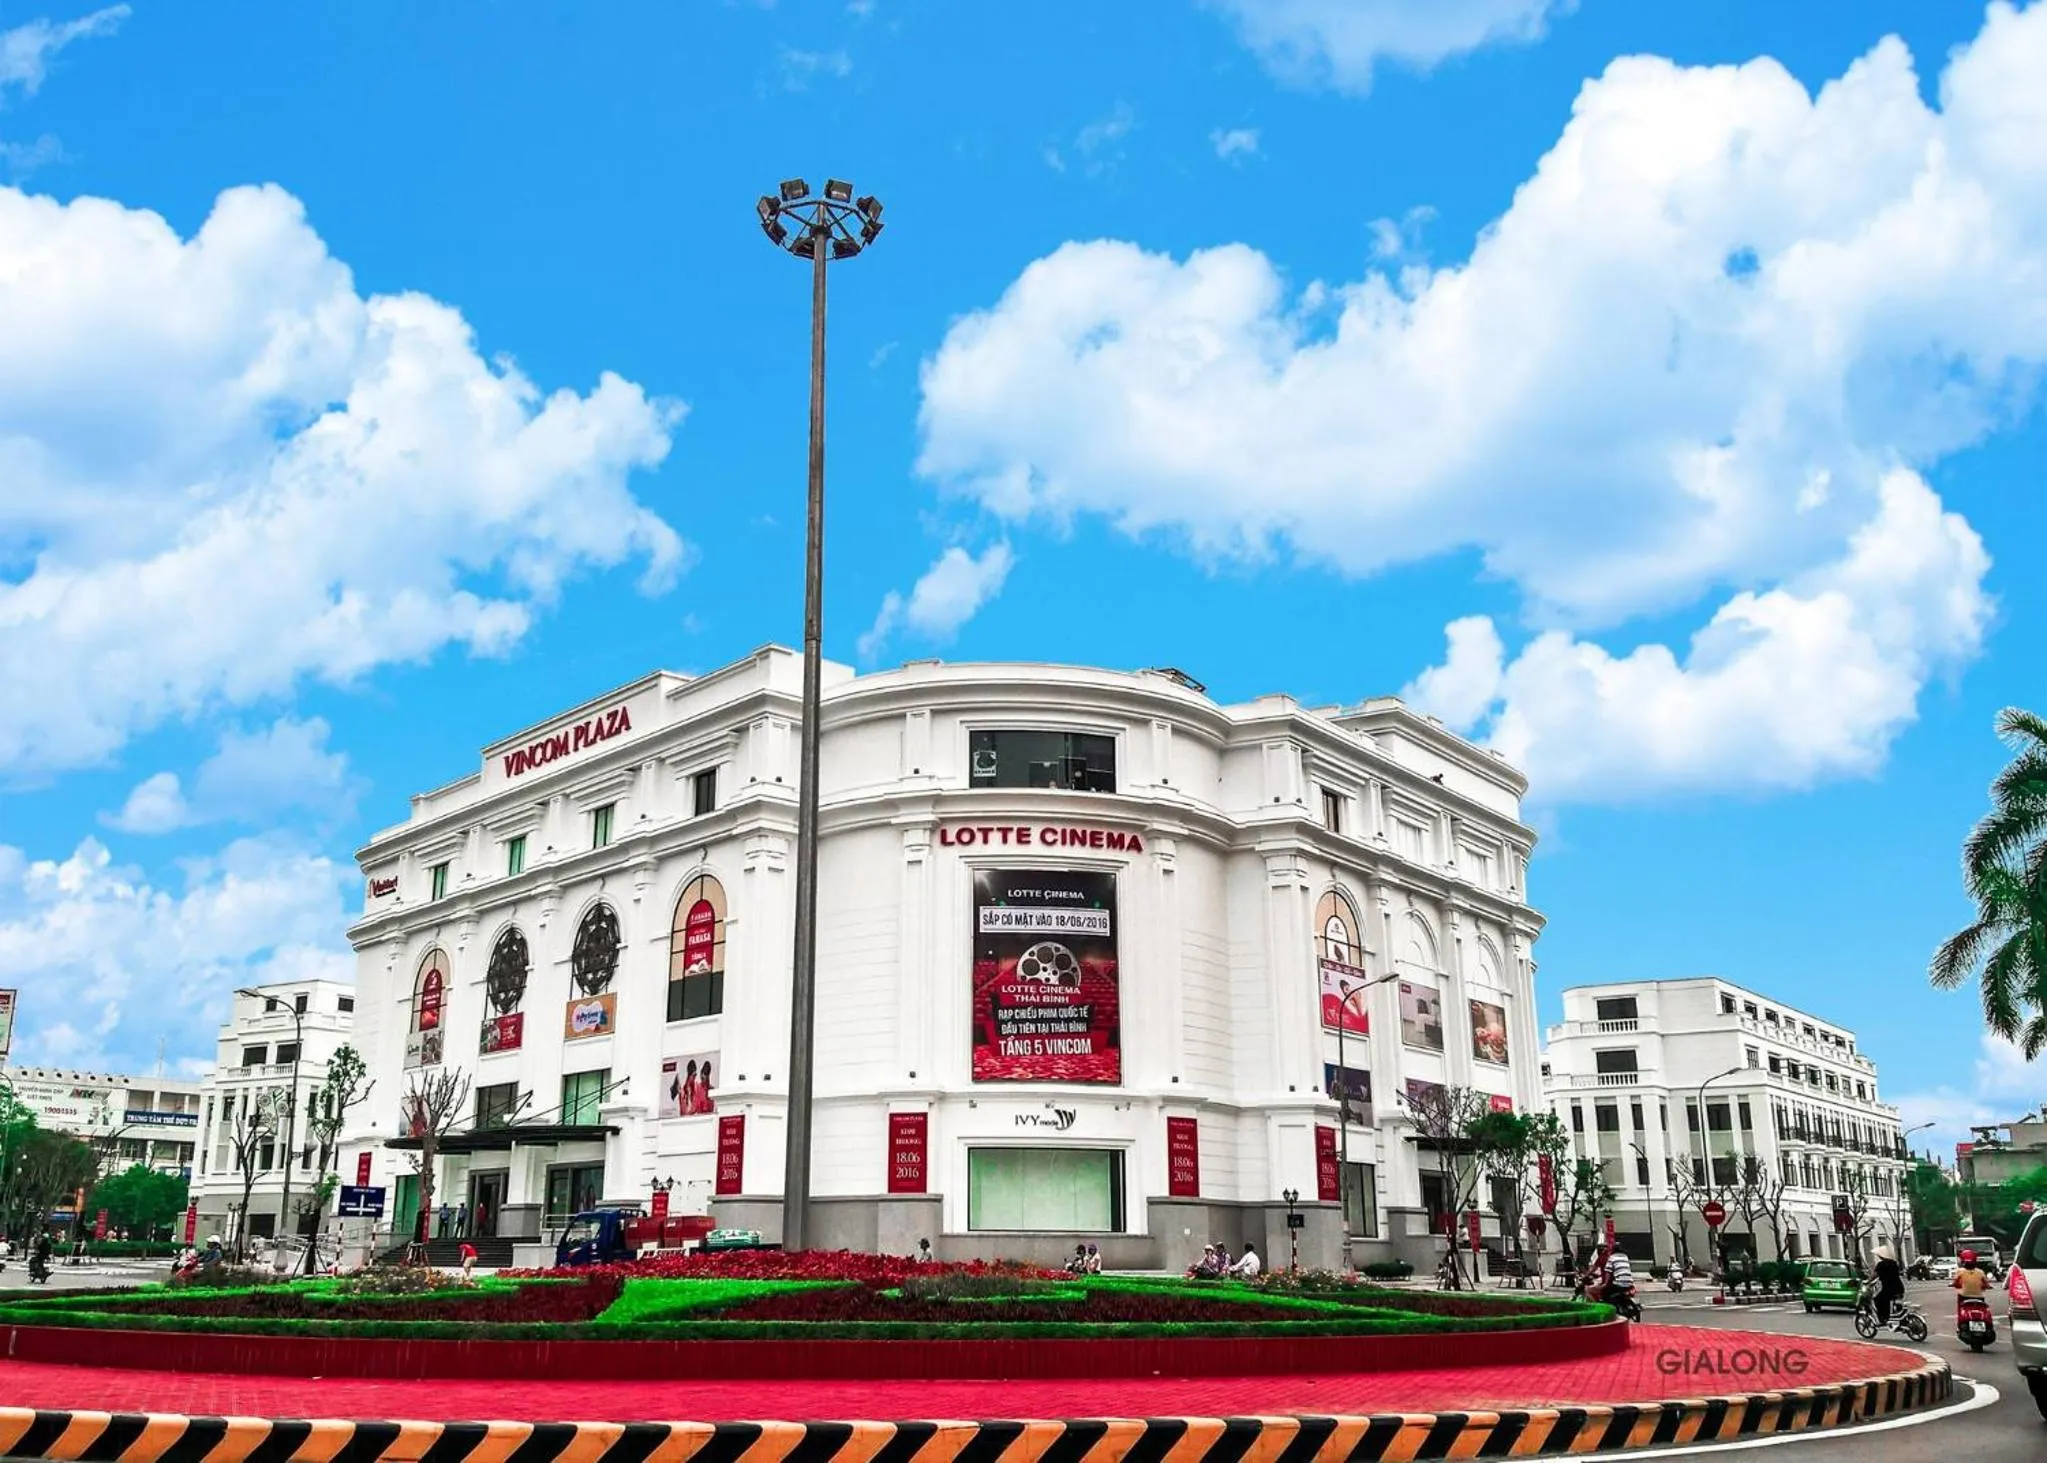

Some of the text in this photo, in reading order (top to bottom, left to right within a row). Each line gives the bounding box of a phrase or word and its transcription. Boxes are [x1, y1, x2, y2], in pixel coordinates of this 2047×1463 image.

[503, 706, 632, 778] VINCOM PLAZA
[940, 827, 1144, 853] LOTTE CINEMA
[1008, 889, 1085, 899] LOTTE CINEMA
[982, 910, 1108, 929] SẮP CÓ MẶT VÀO 18/06/2016
[1002, 985, 1081, 994] LOTTE CINEMA
[1014, 994, 1040, 1003] THÁI
[1038, 1008, 1058, 1019] PHIM
[999, 1036, 1092, 1056] TẦNG 5 VINCOM
[1015, 1114, 1040, 1126] IVY
[896, 1152, 920, 1164] 18.06
[896, 1167, 919, 1178] 2016
